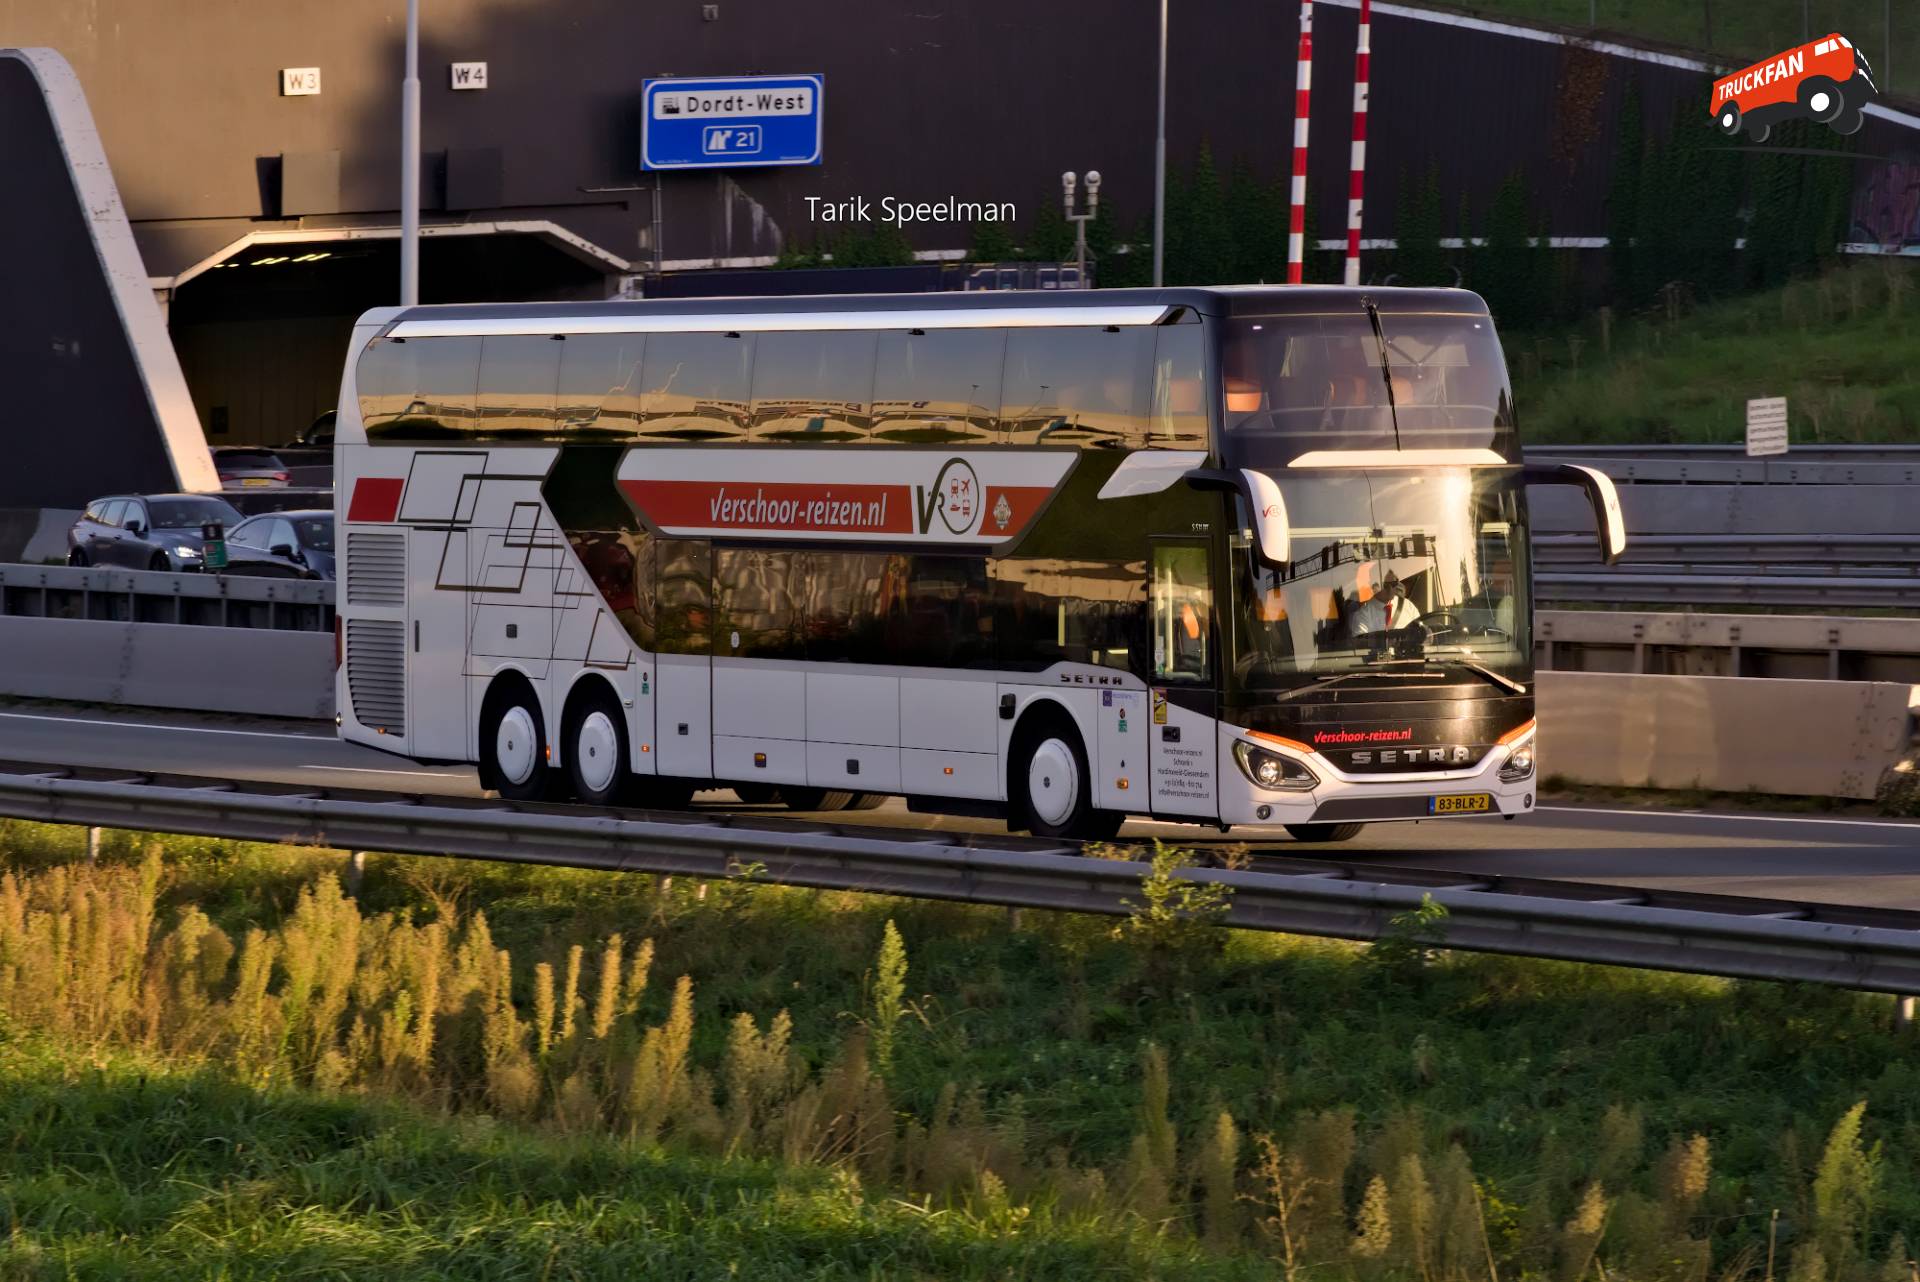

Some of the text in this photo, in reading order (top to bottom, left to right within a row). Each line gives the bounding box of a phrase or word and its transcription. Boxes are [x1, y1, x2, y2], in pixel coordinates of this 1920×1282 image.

[687, 93, 804, 113] Dordt-West
[735, 131, 755, 147] 21
[709, 487, 887, 527] Verschoor-reizen.nl
[1060, 673, 1123, 685] SETRA
[1314, 728, 1412, 743] Verschoor-reizen.nl
[1351, 746, 1470, 765] SETRA
[1438, 796, 1486, 810] 83-BLR-2
